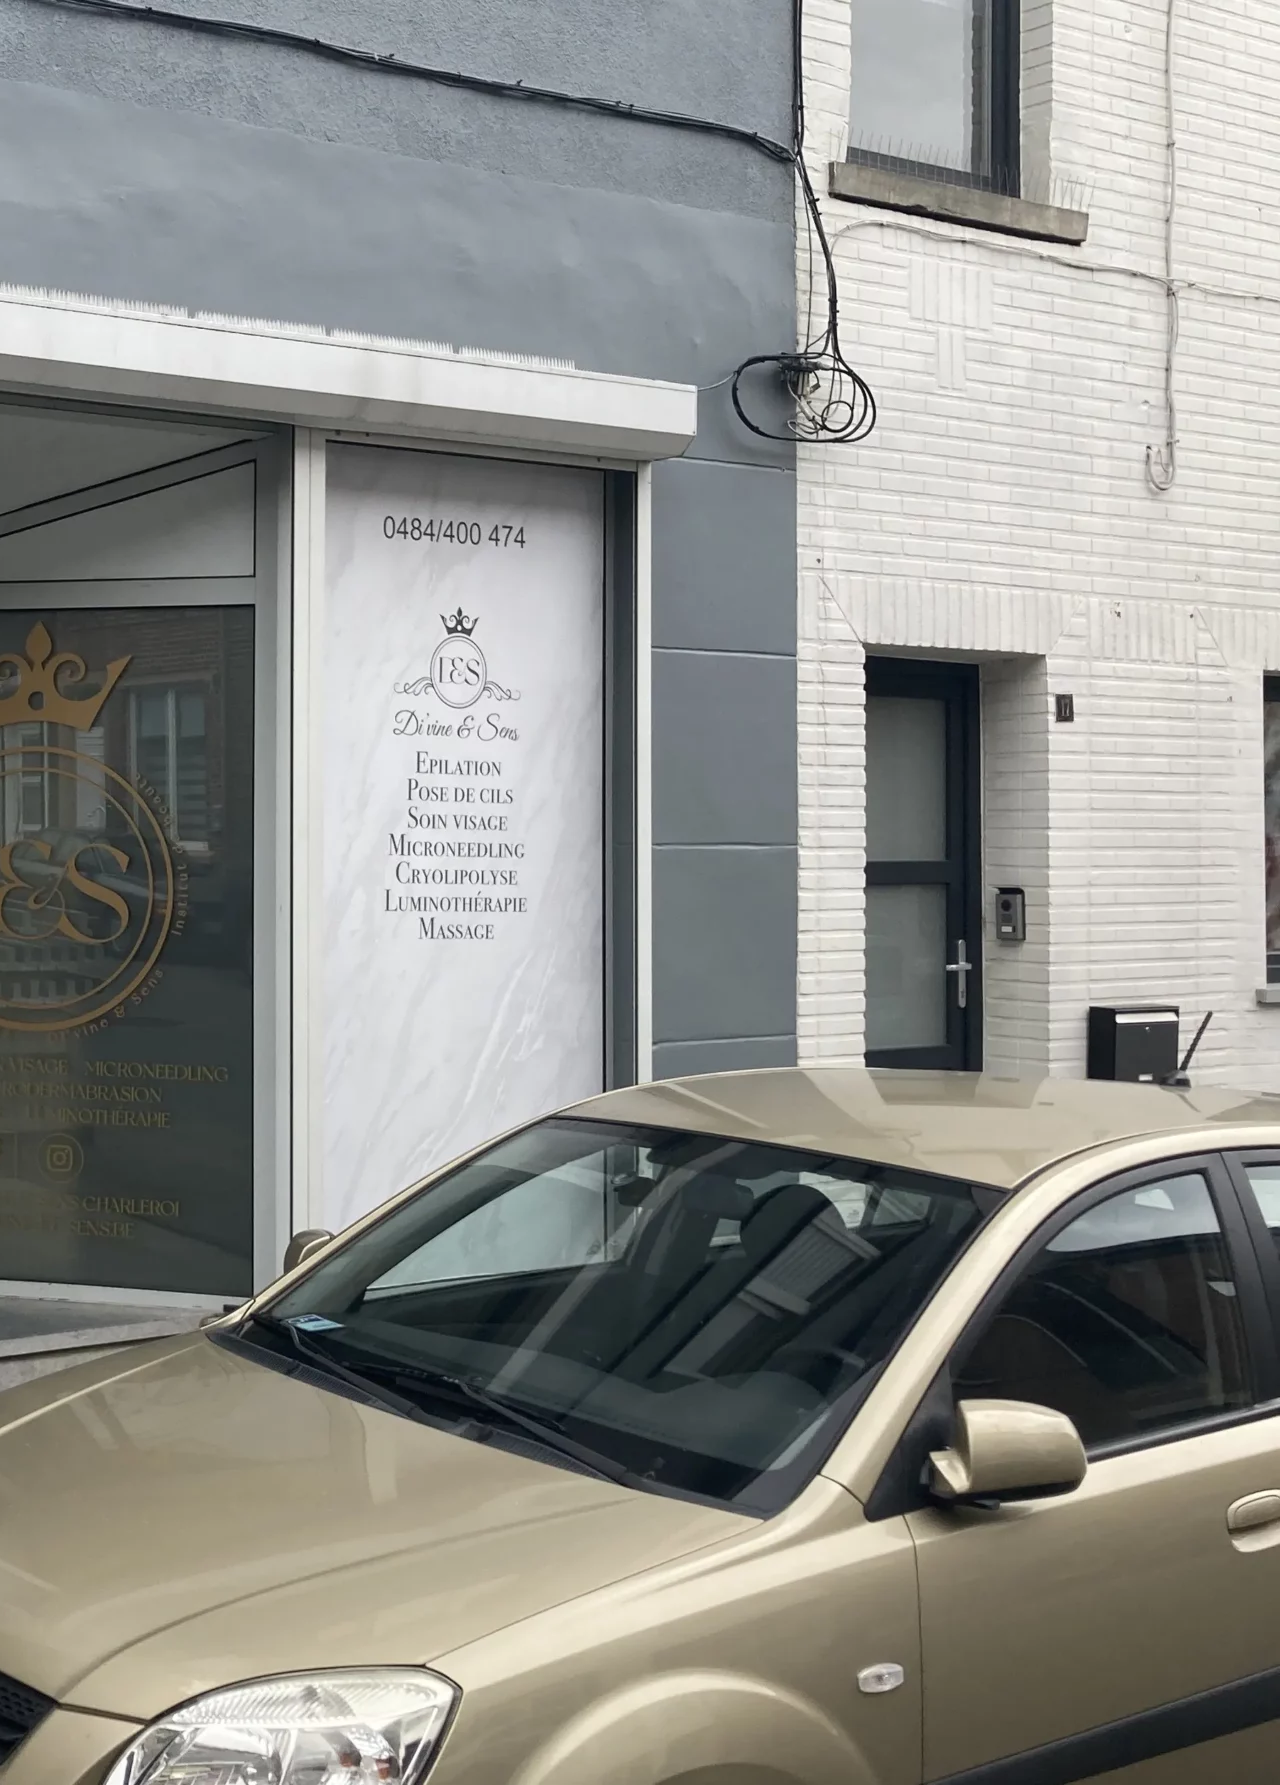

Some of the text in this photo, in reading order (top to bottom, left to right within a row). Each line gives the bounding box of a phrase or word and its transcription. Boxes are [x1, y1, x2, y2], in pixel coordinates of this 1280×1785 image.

[383, 515, 526, 549] 0484/400 474
[393, 709, 520, 742] Di'vine & Sens
[416, 751, 502, 777] EPILATION
[407, 778, 514, 804] POSE DE CILS
[407, 806, 508, 831] SOIN VISAGE
[388, 833, 526, 859] MICRONEEDLING
[395, 861, 519, 886] CRYOLIPOLYSE
[384, 889, 528, 913] LUMINOTHÉRAPIE
[418, 917, 495, 941] MASSAGE
[83, 1061, 229, 1083] MICRONEEDLING
